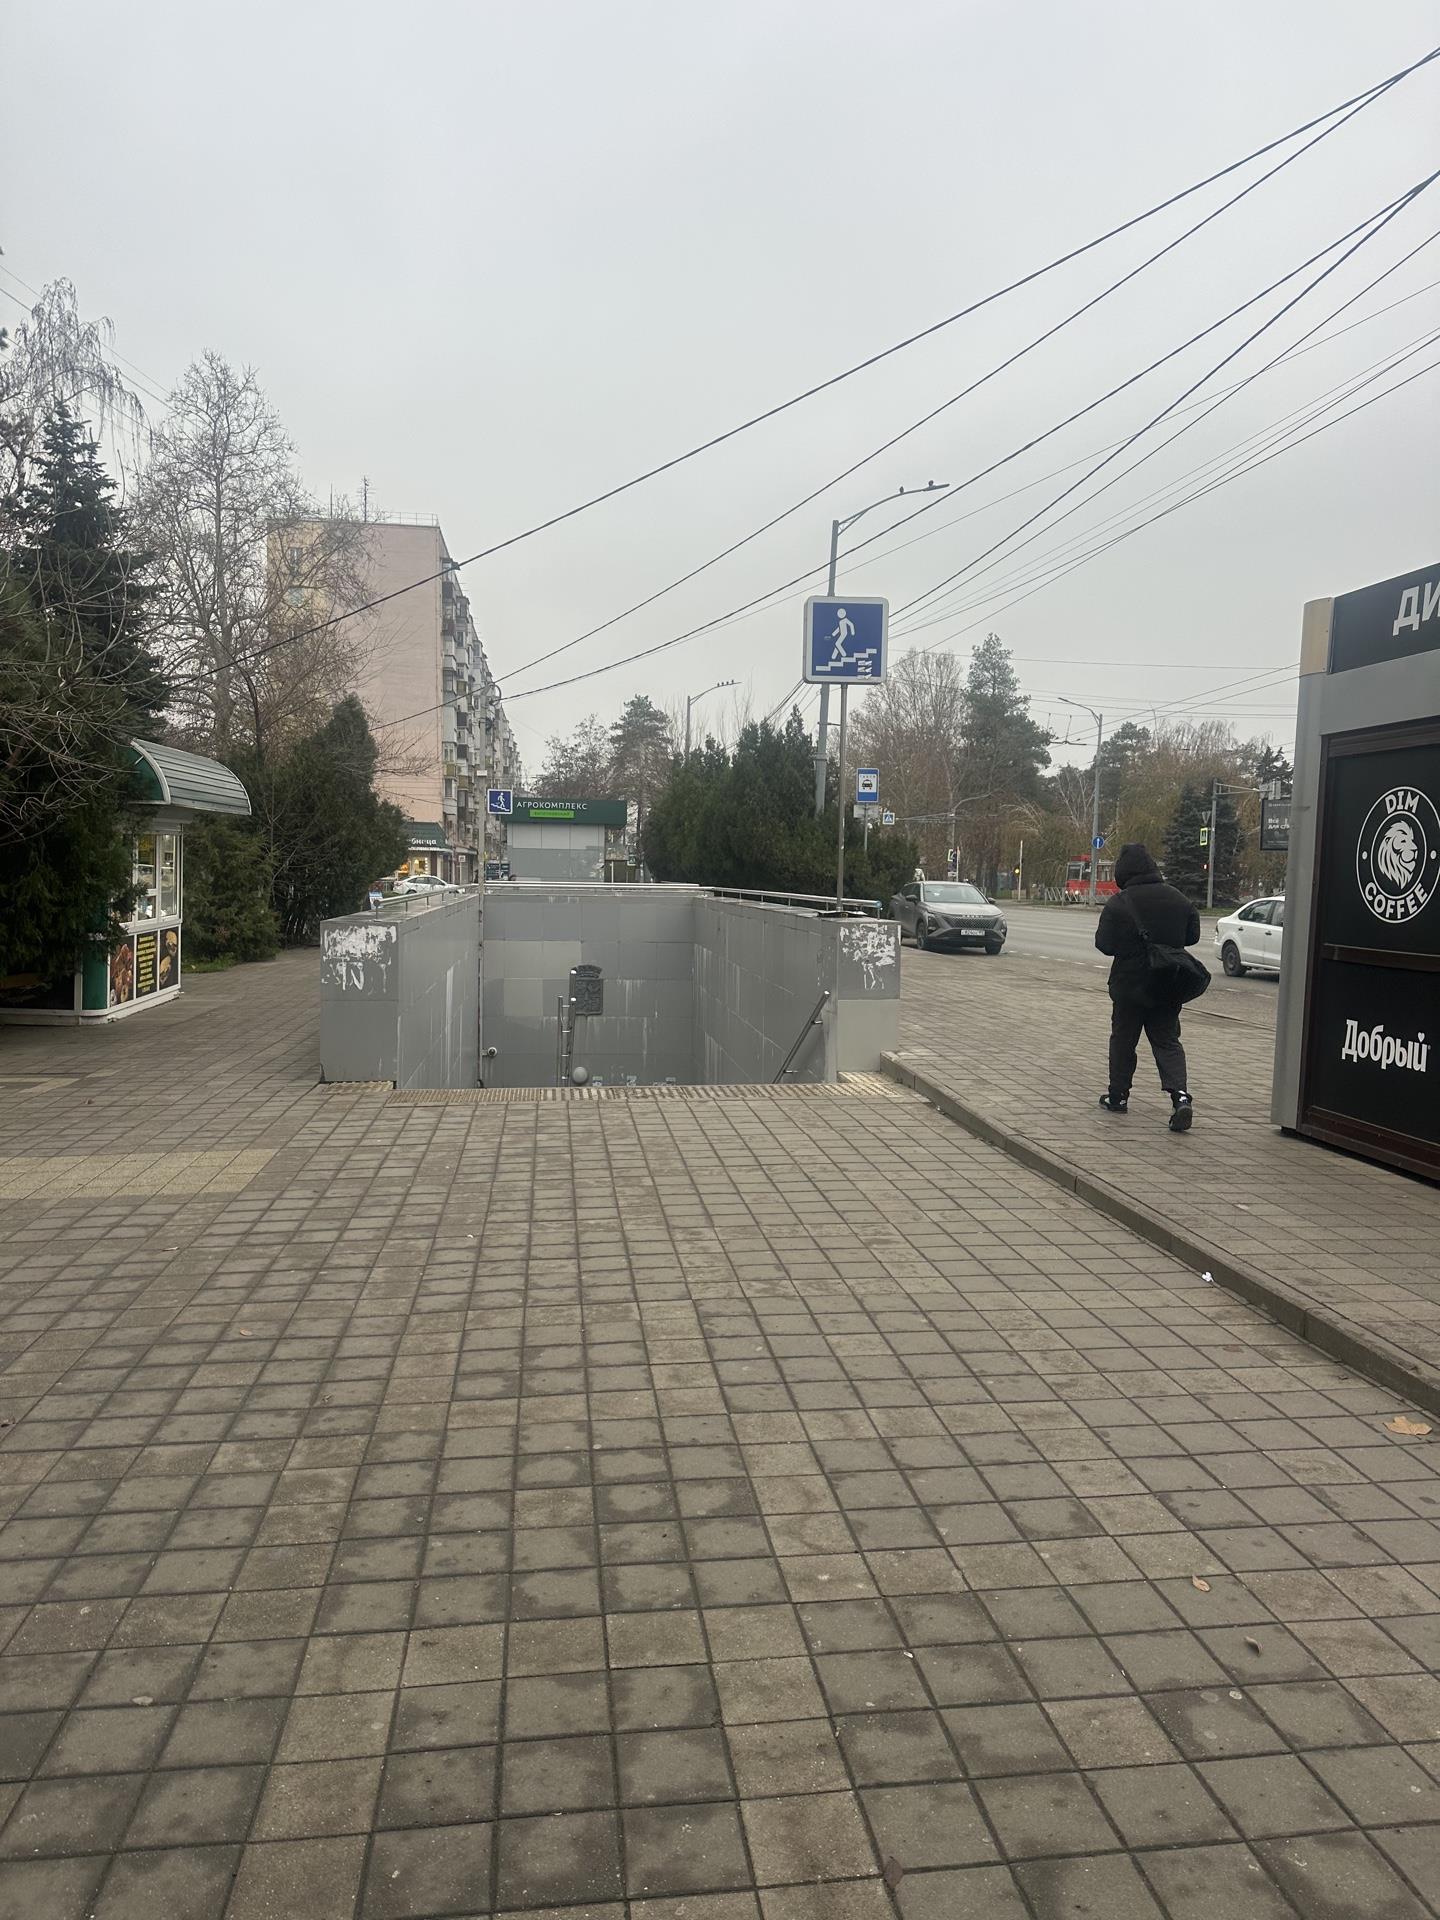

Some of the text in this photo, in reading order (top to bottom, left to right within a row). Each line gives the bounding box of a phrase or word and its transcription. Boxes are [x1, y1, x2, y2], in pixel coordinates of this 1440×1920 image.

[516, 801, 588, 810] АГРОКОМПЛЕКС
[1385, 791, 1419, 814] DIM
[1365, 882, 1428, 919] COFFEE
[1341, 1019, 1428, 1072] Добрый
